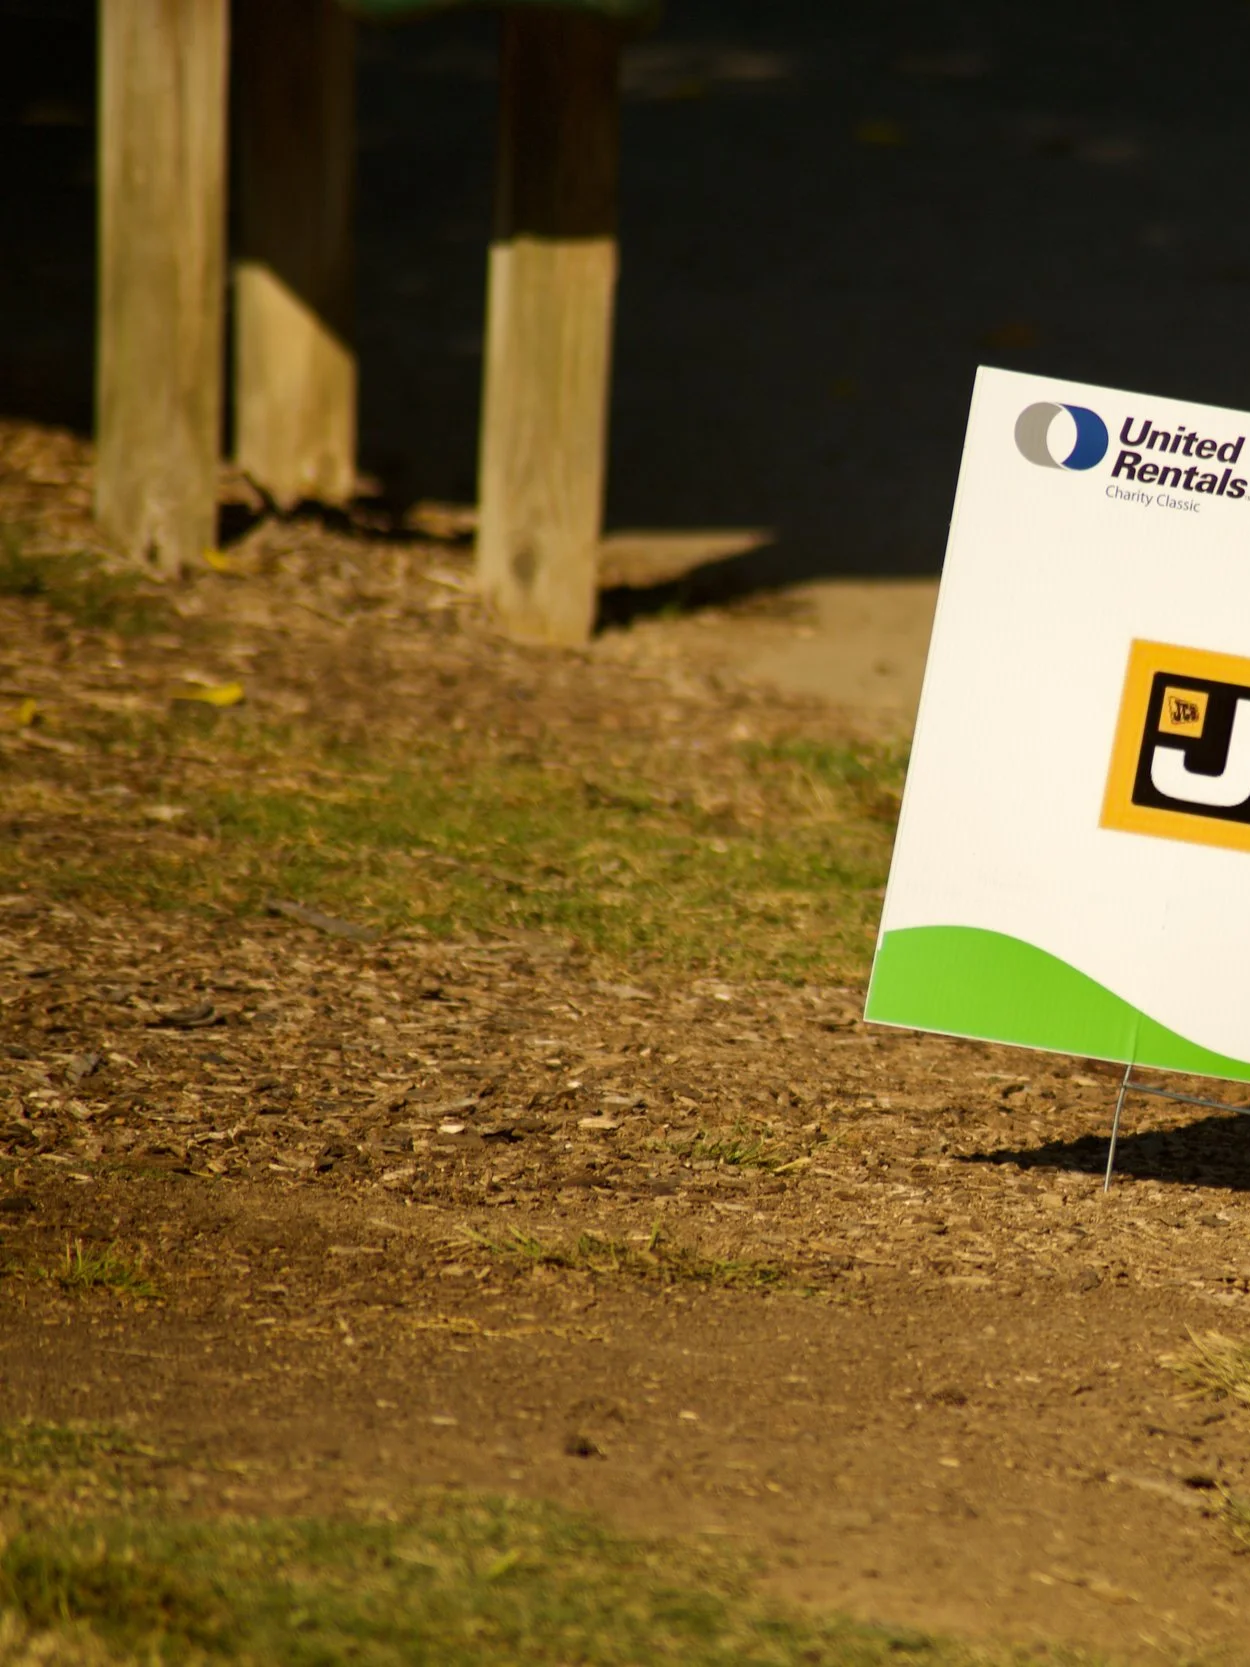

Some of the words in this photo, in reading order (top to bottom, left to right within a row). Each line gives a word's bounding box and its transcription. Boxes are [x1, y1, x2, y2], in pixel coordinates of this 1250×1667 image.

[1119, 417, 1246, 464] United
[1110, 449, 1248, 500] Rentals
[1105, 485, 1153, 507] Charity
[1156, 494, 1201, 513] Classic
